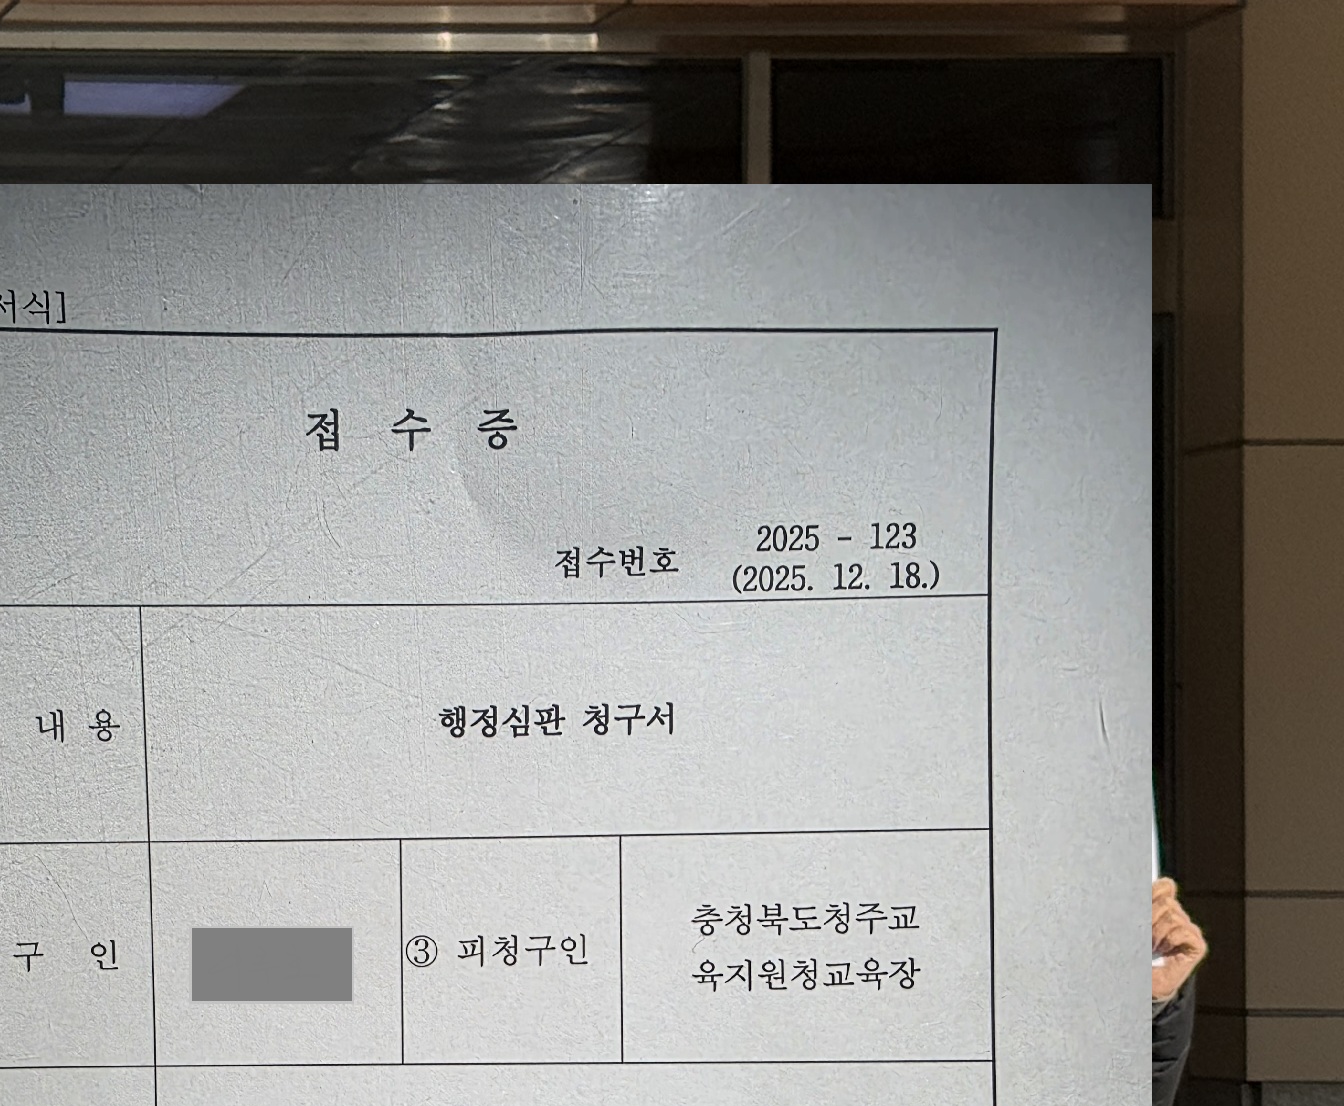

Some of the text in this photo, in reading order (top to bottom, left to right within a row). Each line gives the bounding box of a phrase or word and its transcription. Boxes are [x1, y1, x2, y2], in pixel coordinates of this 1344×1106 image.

[757, 524, 820, 551] 2025
[870, 521, 916, 550] 123
[555, 548, 679, 578] 접수번호
[732, 561, 940, 593] (2025. 12. 18.)
[439, 702, 675, 738] 행정심판 청구서
[691, 902, 920, 935] 충청북도청주교
[458, 933, 588, 968] 피청구인
[692, 958, 920, 991] 육지원청교육장
